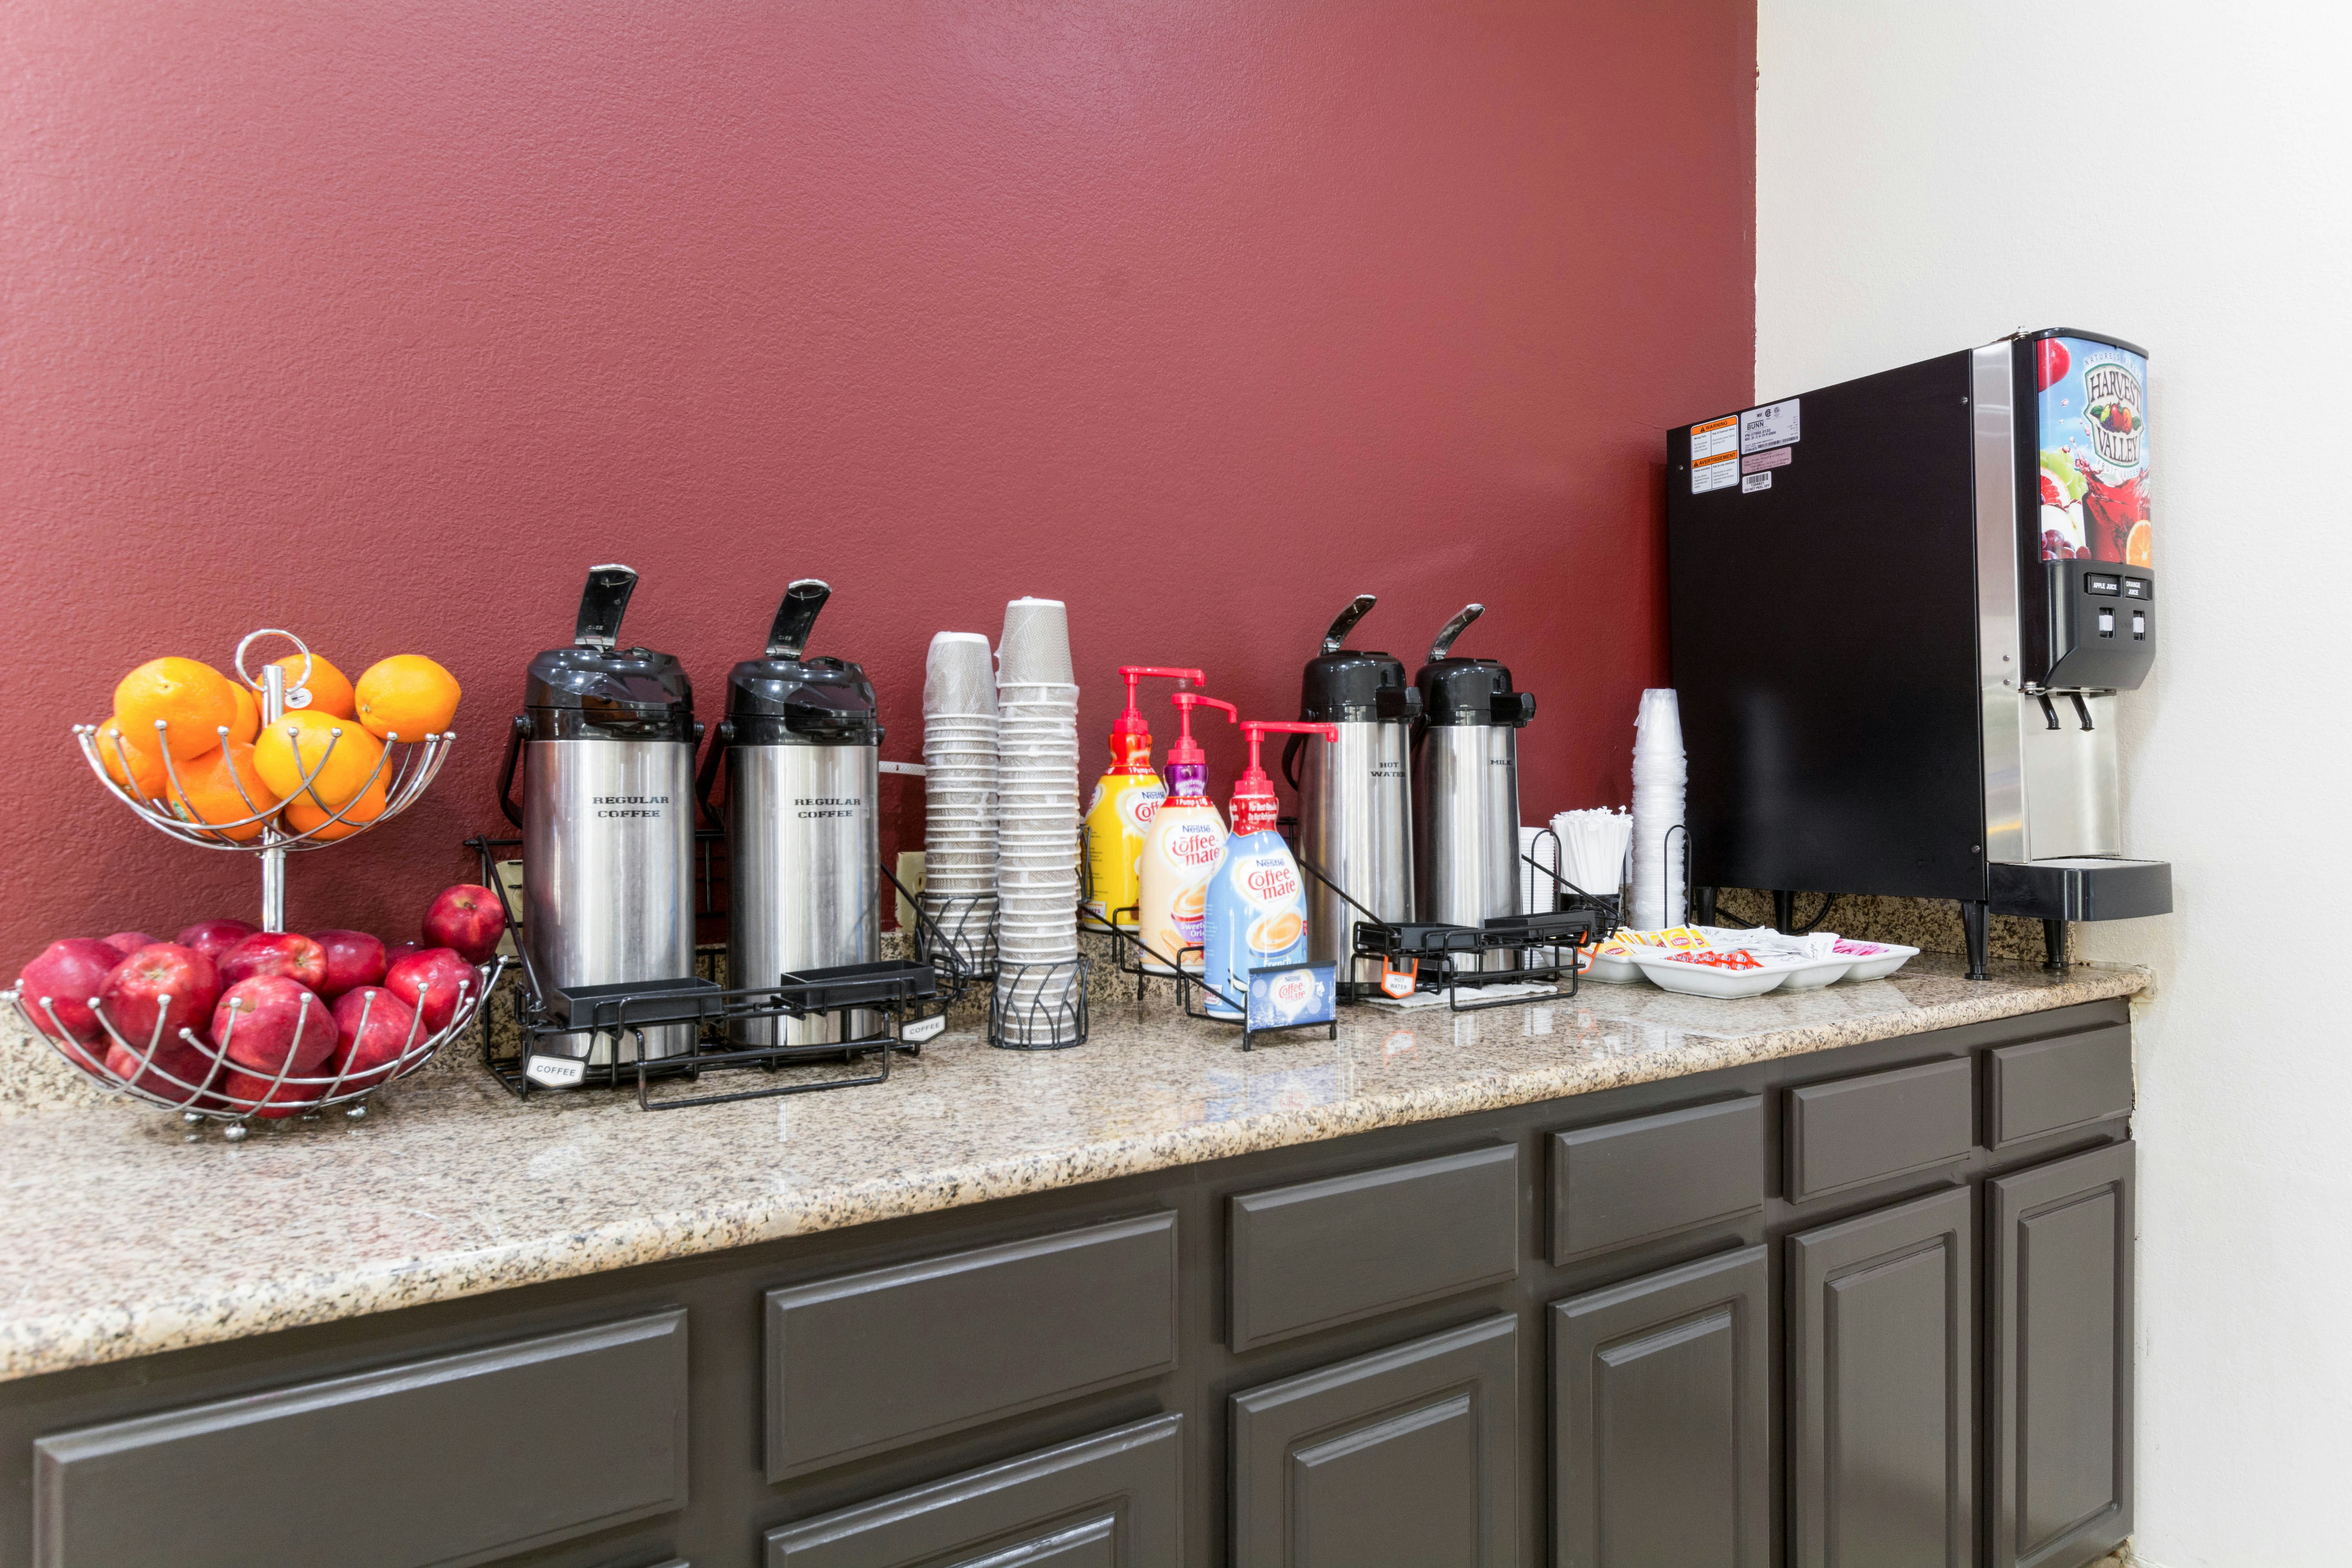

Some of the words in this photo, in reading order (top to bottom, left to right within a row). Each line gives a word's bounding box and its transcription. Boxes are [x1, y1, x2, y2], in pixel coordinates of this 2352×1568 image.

[2090, 371, 2141, 413] HARVEST
[1705, 421, 1727, 430] WARNING
[1747, 421, 1764, 430] BUNN
[2096, 425, 2138, 462] VALLEY
[1699, 452, 1736, 465] AVERTISSEMENT
[2098, 460, 2116, 475] FRUIT
[2120, 468, 2138, 478] JUICES
[1135, 800, 1159, 821] Coff
[1186, 848, 1219, 866] mate
[1263, 880, 1296, 900] mate
[1286, 991, 1305, 1005] mate
[910, 1022, 940, 1034] COFFEE
[537, 1065, 576, 1076] COFFEE
